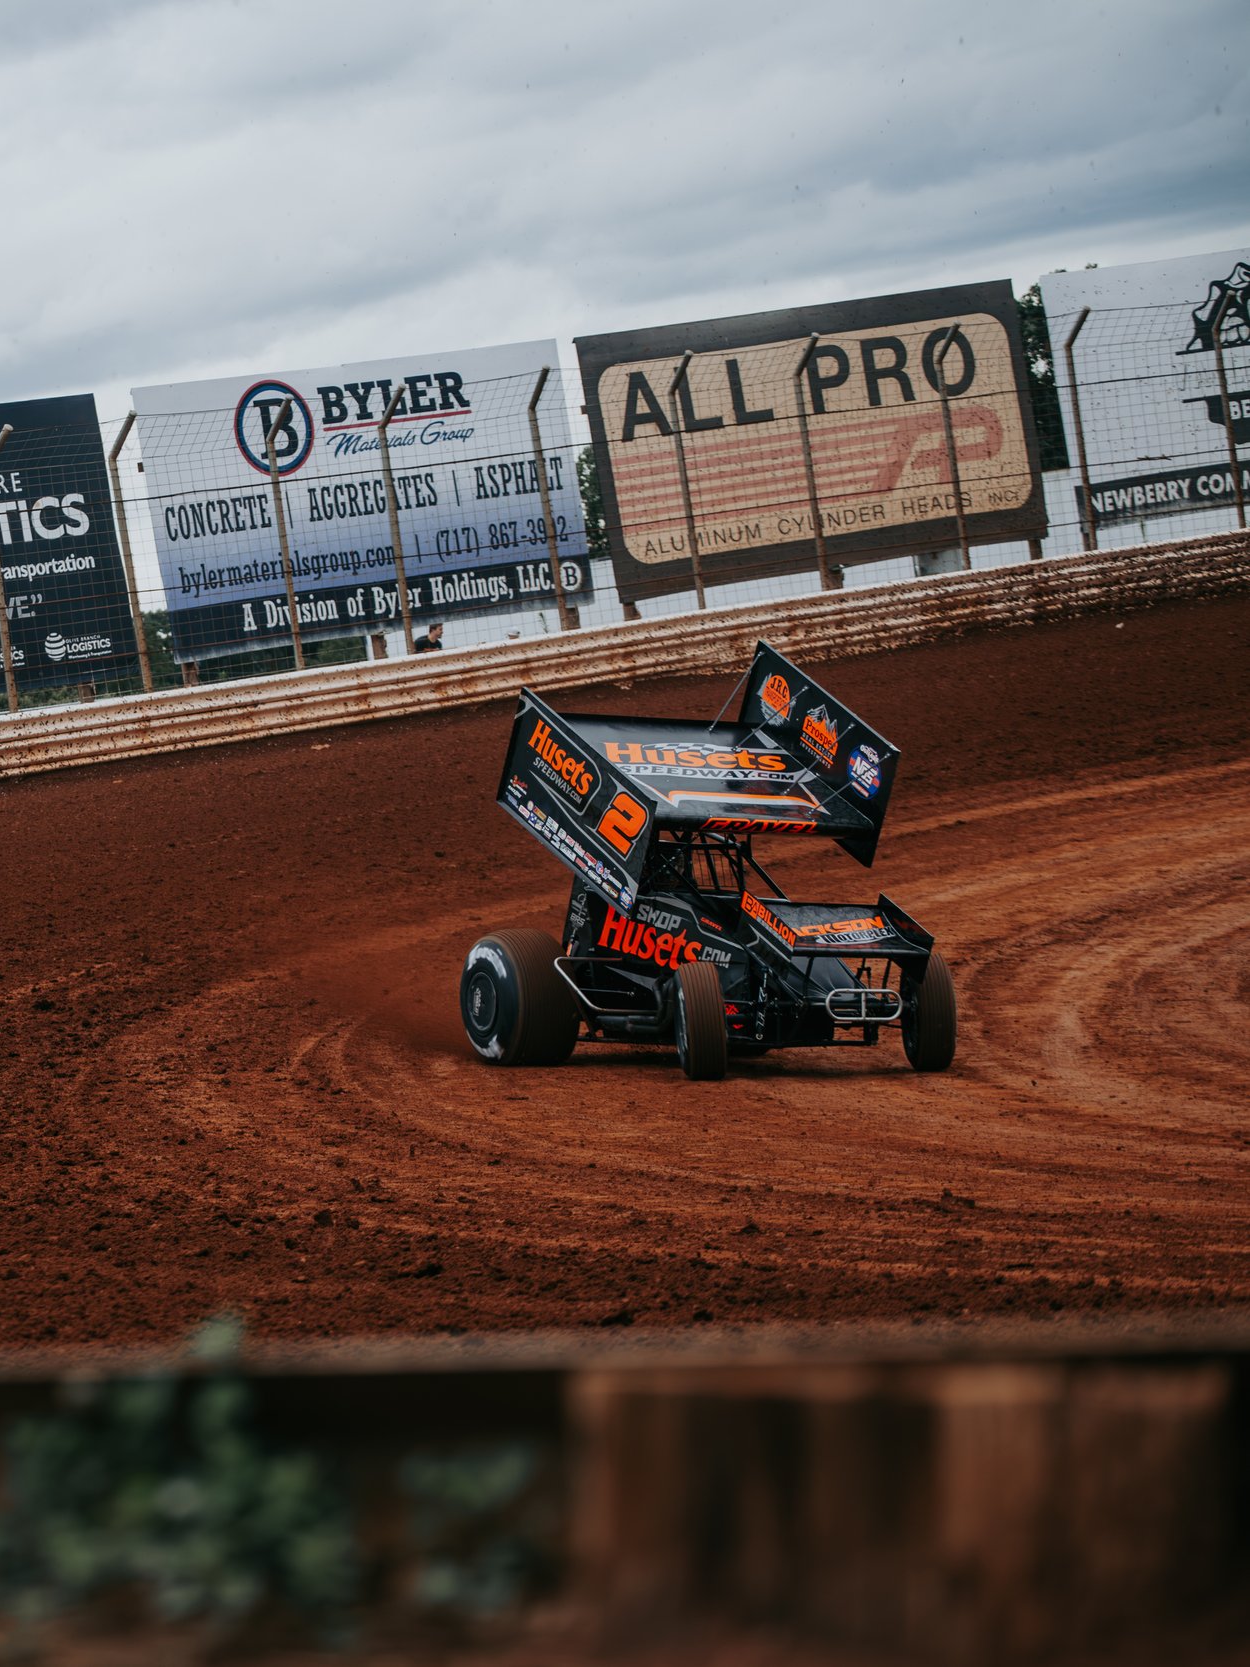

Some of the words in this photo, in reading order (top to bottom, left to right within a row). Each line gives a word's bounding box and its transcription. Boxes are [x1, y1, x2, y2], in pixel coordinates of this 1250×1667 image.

[316, 371, 472, 424] BYLER
[622, 358, 775, 442] ALL
[803, 326, 976, 414] PRO
[253, 397, 299, 460] B
[326, 429, 417, 459] Mateials
[420, 420, 475, 447] Group
[902, 491, 973, 515] HEADS
[1091, 477, 1191, 512] NEWBERRY
[165, 494, 272, 542] CONCRETE
[436, 526, 480, 563] (717)
[243, 603, 258, 632] A
[263, 594, 339, 628] Division
[347, 587, 366, 618] of
[371, 583, 422, 619] Byler
[429, 571, 514, 605] Holdings,
[516, 562, 556, 593] LLC.
[66, 638, 111, 653] LOGISTICS
[527, 718, 594, 796] Husets
[602, 742, 787, 771] Husets
[620, 765, 795, 781] SPEEDWAY.COM
[533, 757, 583, 804] SPEEDWAY.COM
[597, 792, 648, 856] 2
[701, 817, 818, 834] GRAVEL
[757, 904, 797, 947] BILLION
